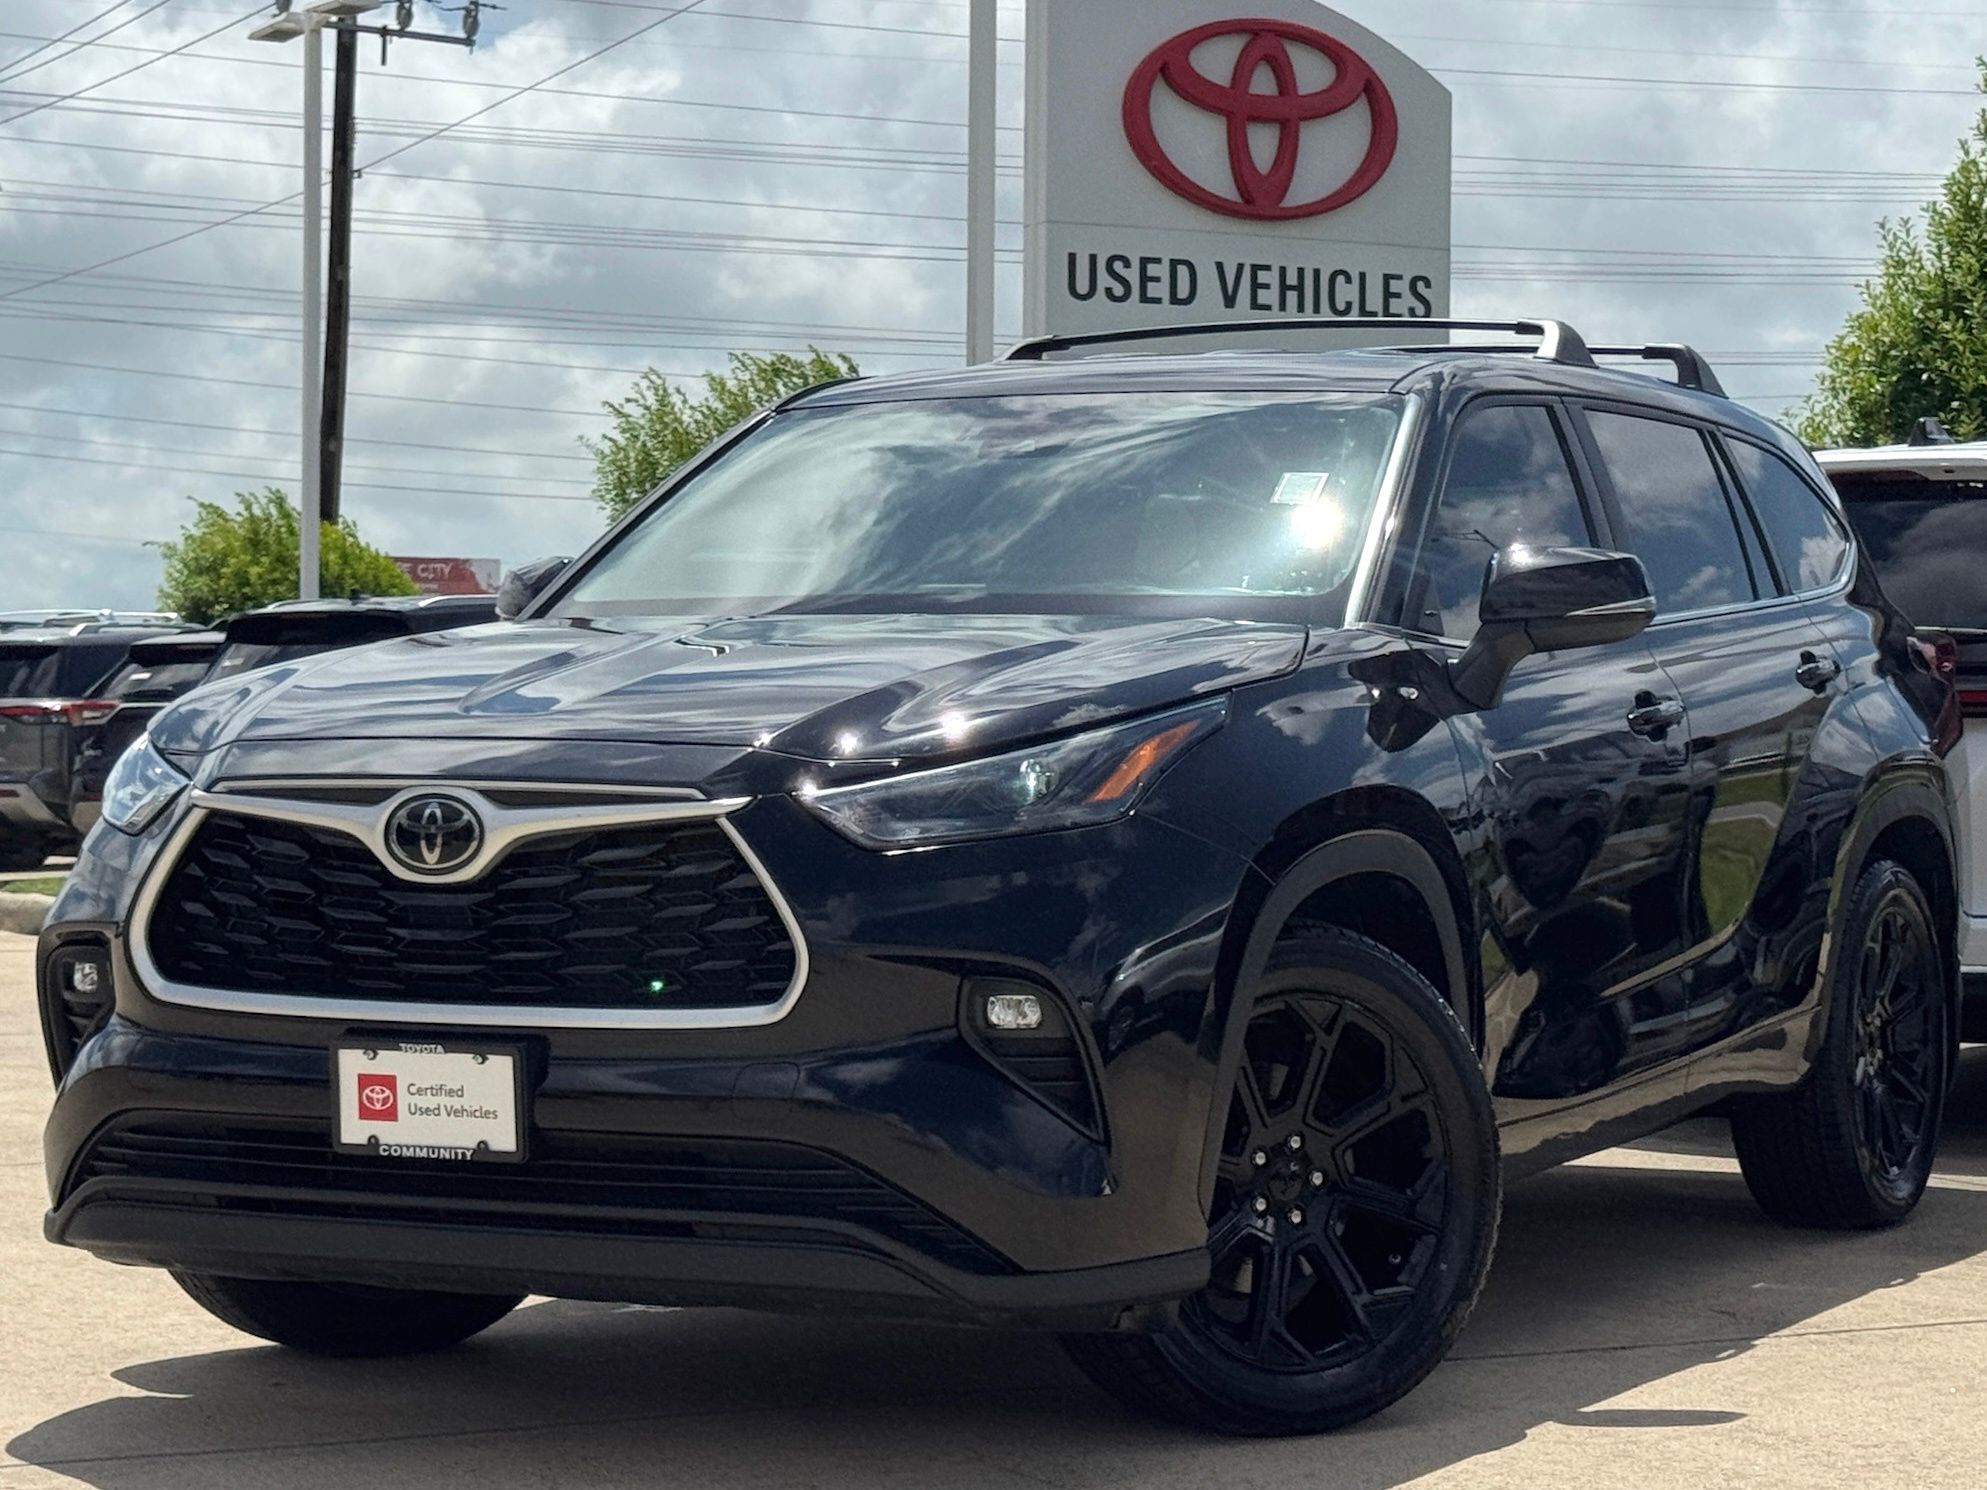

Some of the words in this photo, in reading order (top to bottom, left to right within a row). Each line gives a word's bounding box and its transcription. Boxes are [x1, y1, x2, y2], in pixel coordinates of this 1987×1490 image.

[1067, 252, 1197, 306] USED
[1214, 261, 1432, 318] VEHICLES
[398, 1042, 446, 1055] TOYOTA
[407, 1083, 464, 1098] Certified
[408, 1103, 440, 1117] Used
[445, 1105, 498, 1119] Vehicles
[379, 1145, 474, 1160] COMMUNITY
